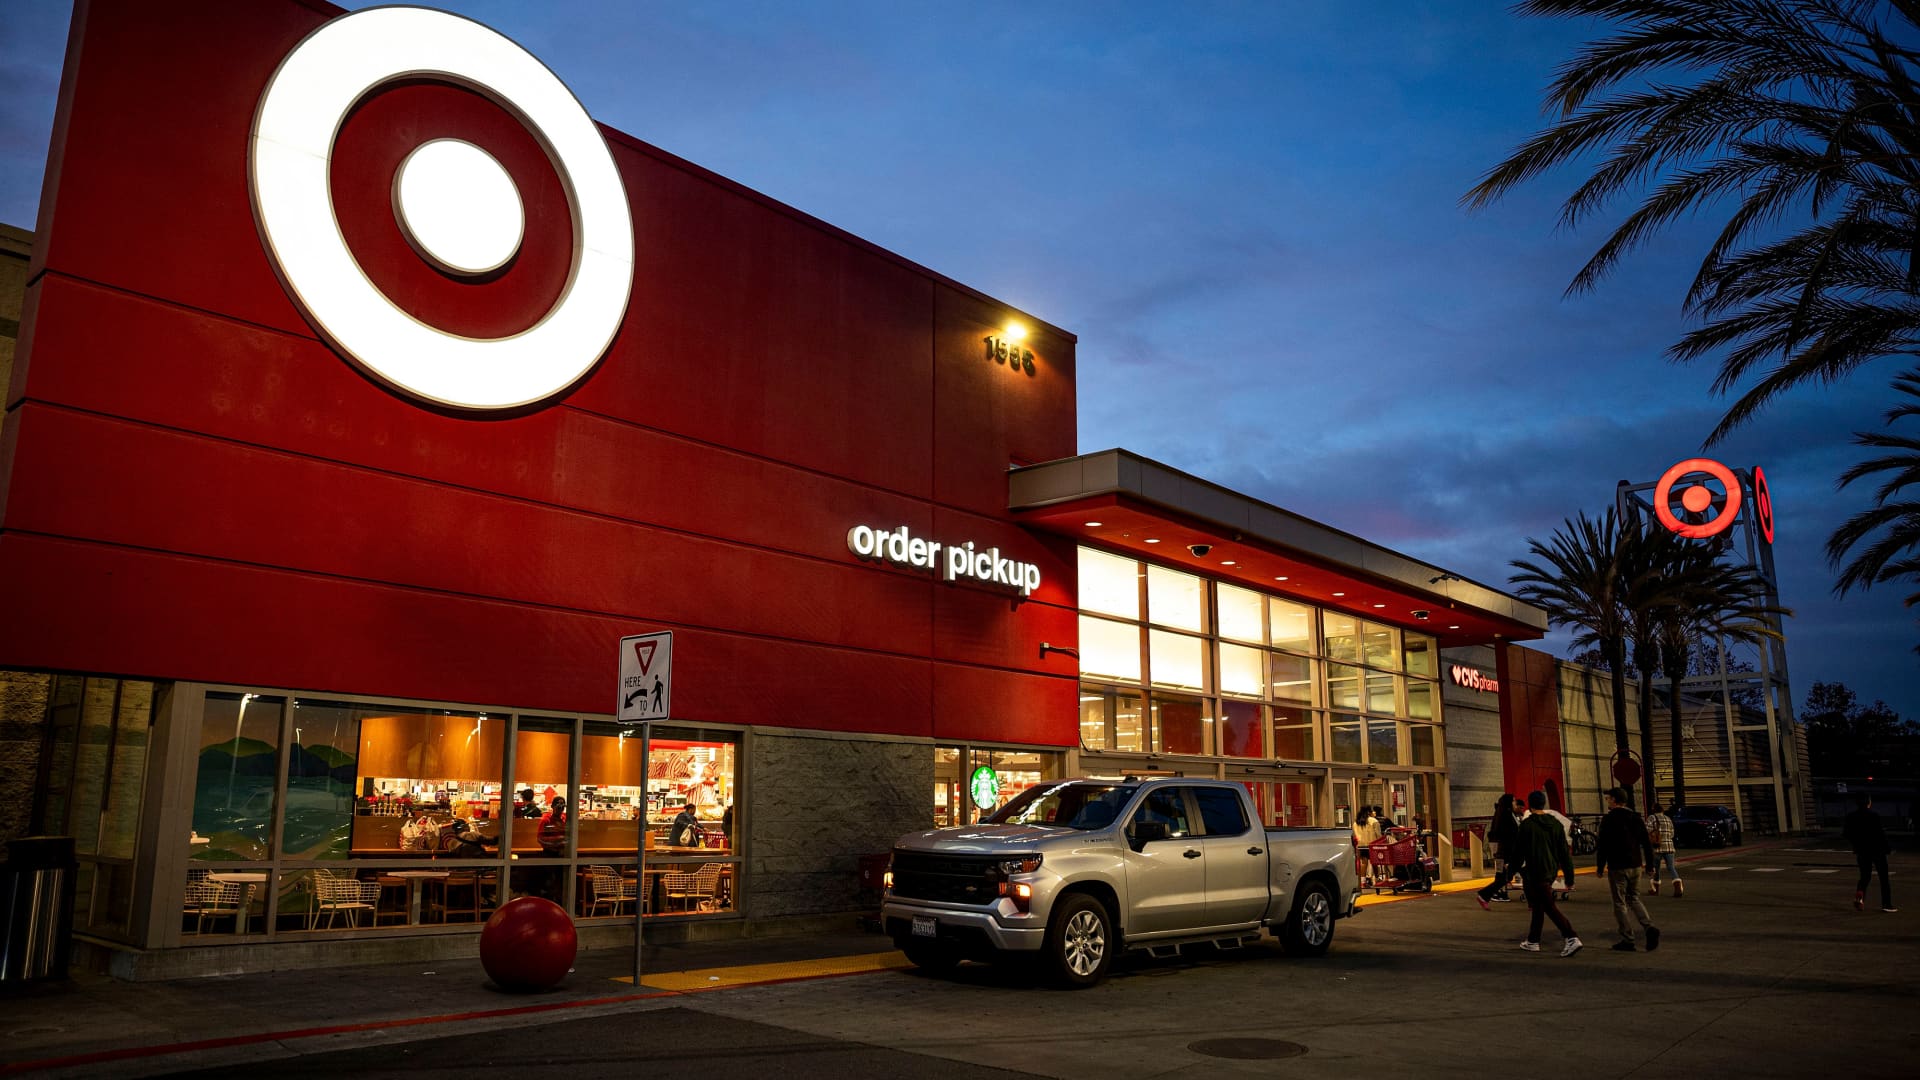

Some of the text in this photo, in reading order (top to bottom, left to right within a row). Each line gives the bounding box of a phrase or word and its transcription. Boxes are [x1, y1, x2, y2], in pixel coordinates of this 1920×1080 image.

[848, 526, 1041, 596] order pickup
[624, 676, 641, 688] HERE
[1461, 667, 1480, 688] CVS
[640, 700, 648, 711] TO
